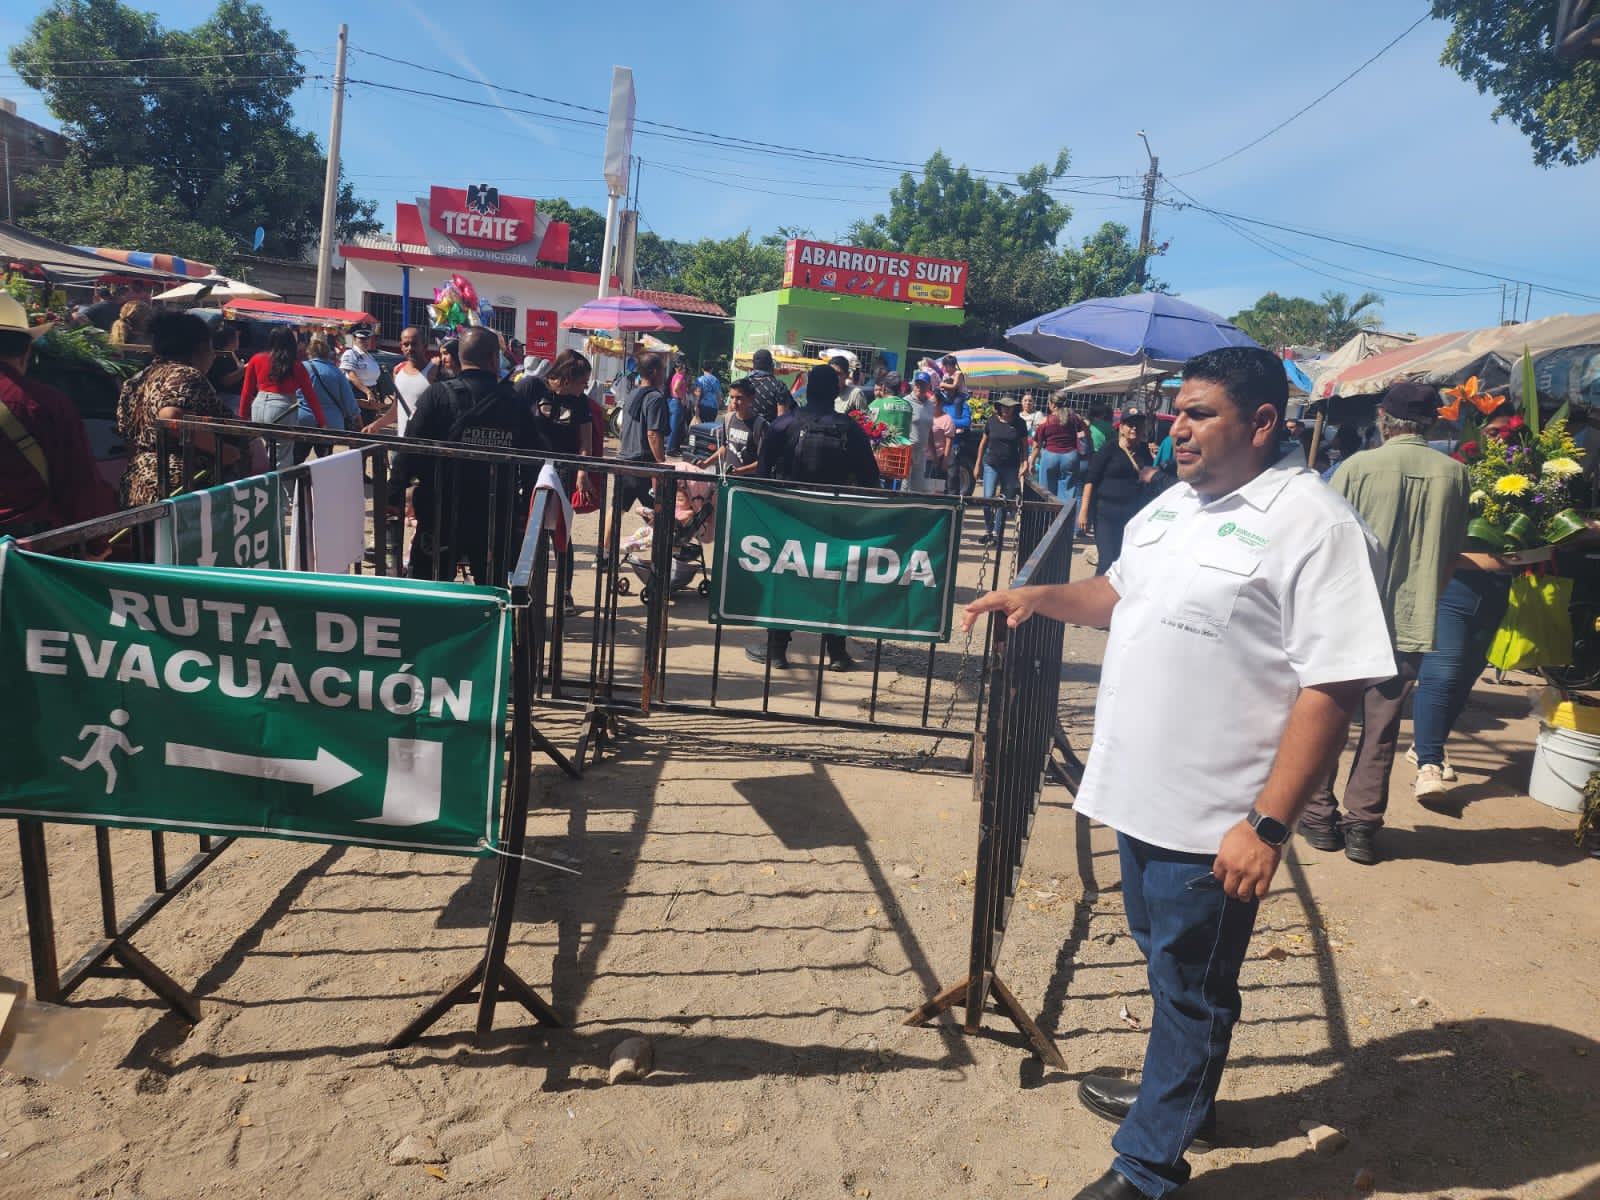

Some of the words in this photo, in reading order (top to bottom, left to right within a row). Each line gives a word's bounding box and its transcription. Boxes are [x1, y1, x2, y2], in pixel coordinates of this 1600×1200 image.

[440, 210, 521, 241] TECATE
[486, 250, 528, 263] VICTORIA
[799, 246, 911, 278] ABARROTES
[915, 261, 963, 284] SURY
[738, 535, 937, 588] SALIDA
[109, 588, 292, 649] RUTA
[315, 611, 402, 658] DE
[25, 628, 473, 722] EVACUACIÓN
